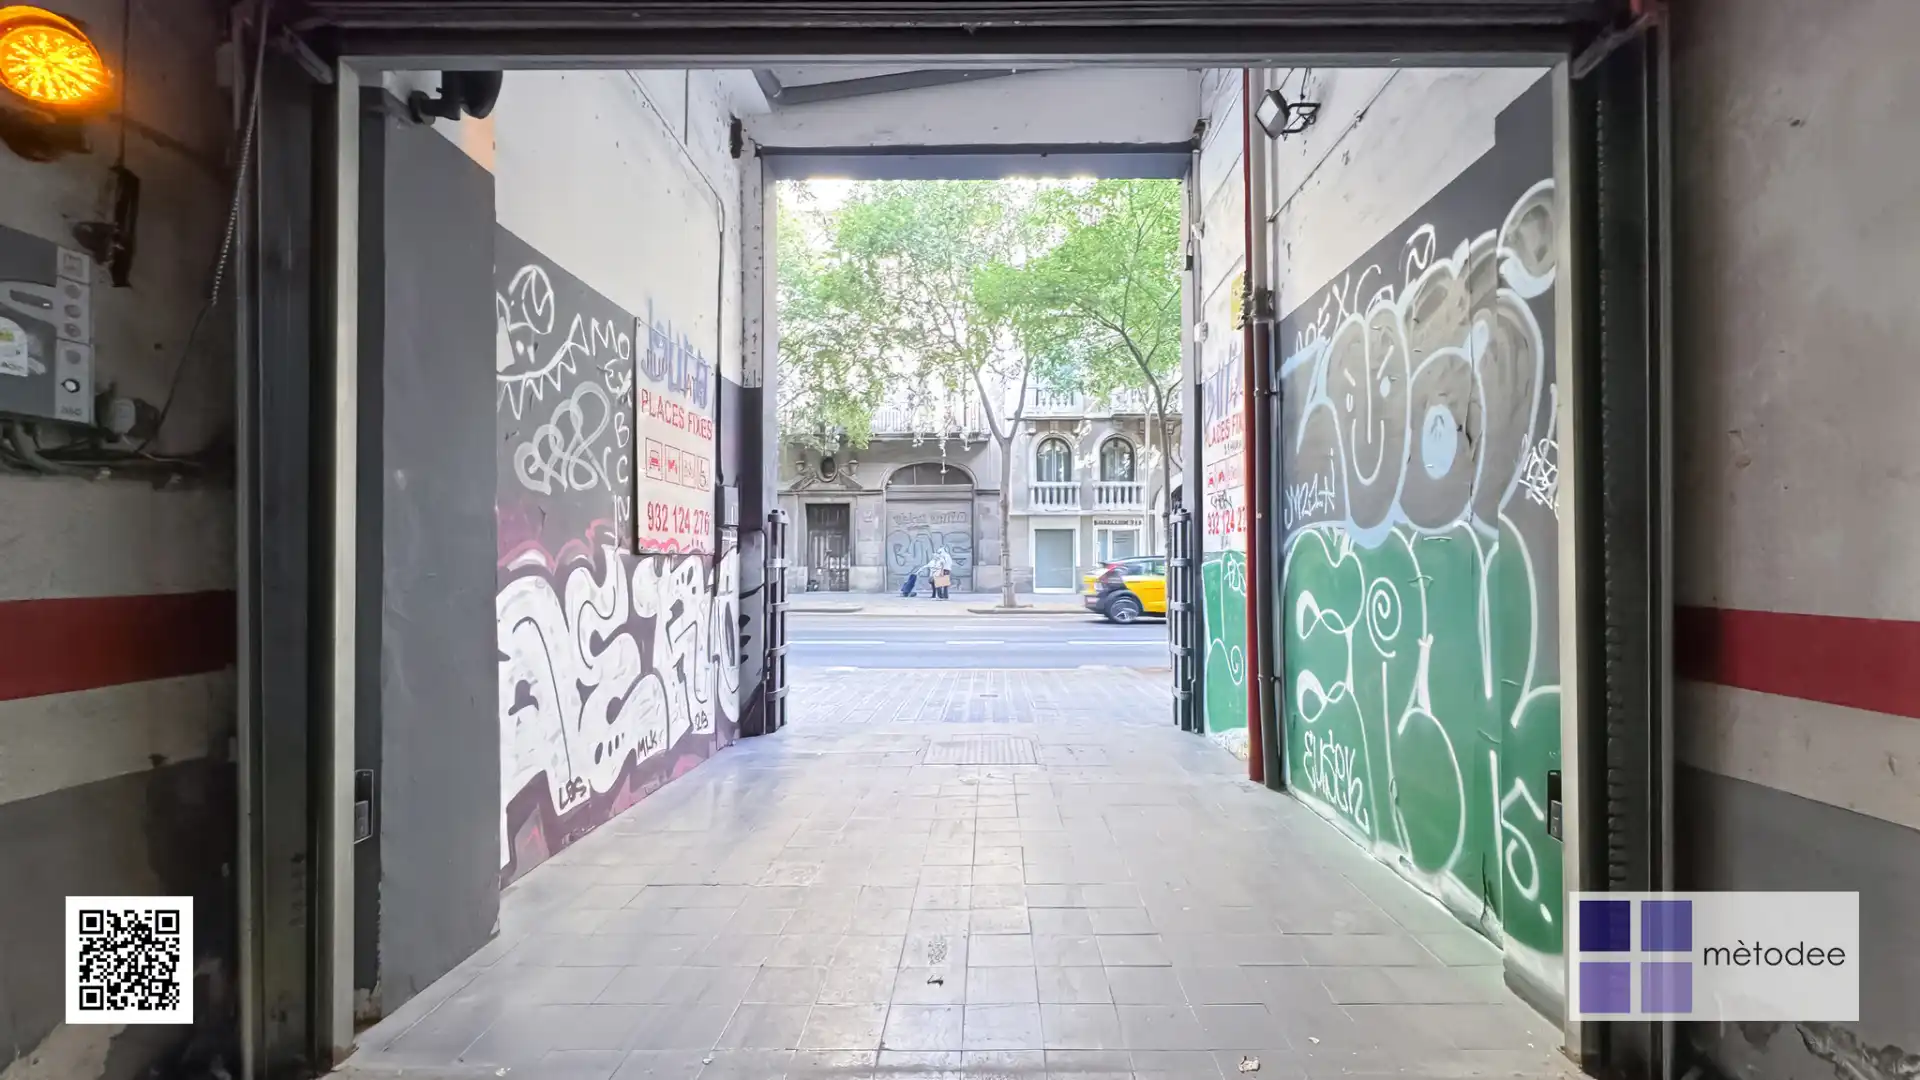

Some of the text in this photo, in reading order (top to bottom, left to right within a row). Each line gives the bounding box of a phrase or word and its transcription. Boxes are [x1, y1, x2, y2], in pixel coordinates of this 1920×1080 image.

[641, 388, 713, 441] PLACES FIXES
[647, 501, 711, 536] 932 124 276
